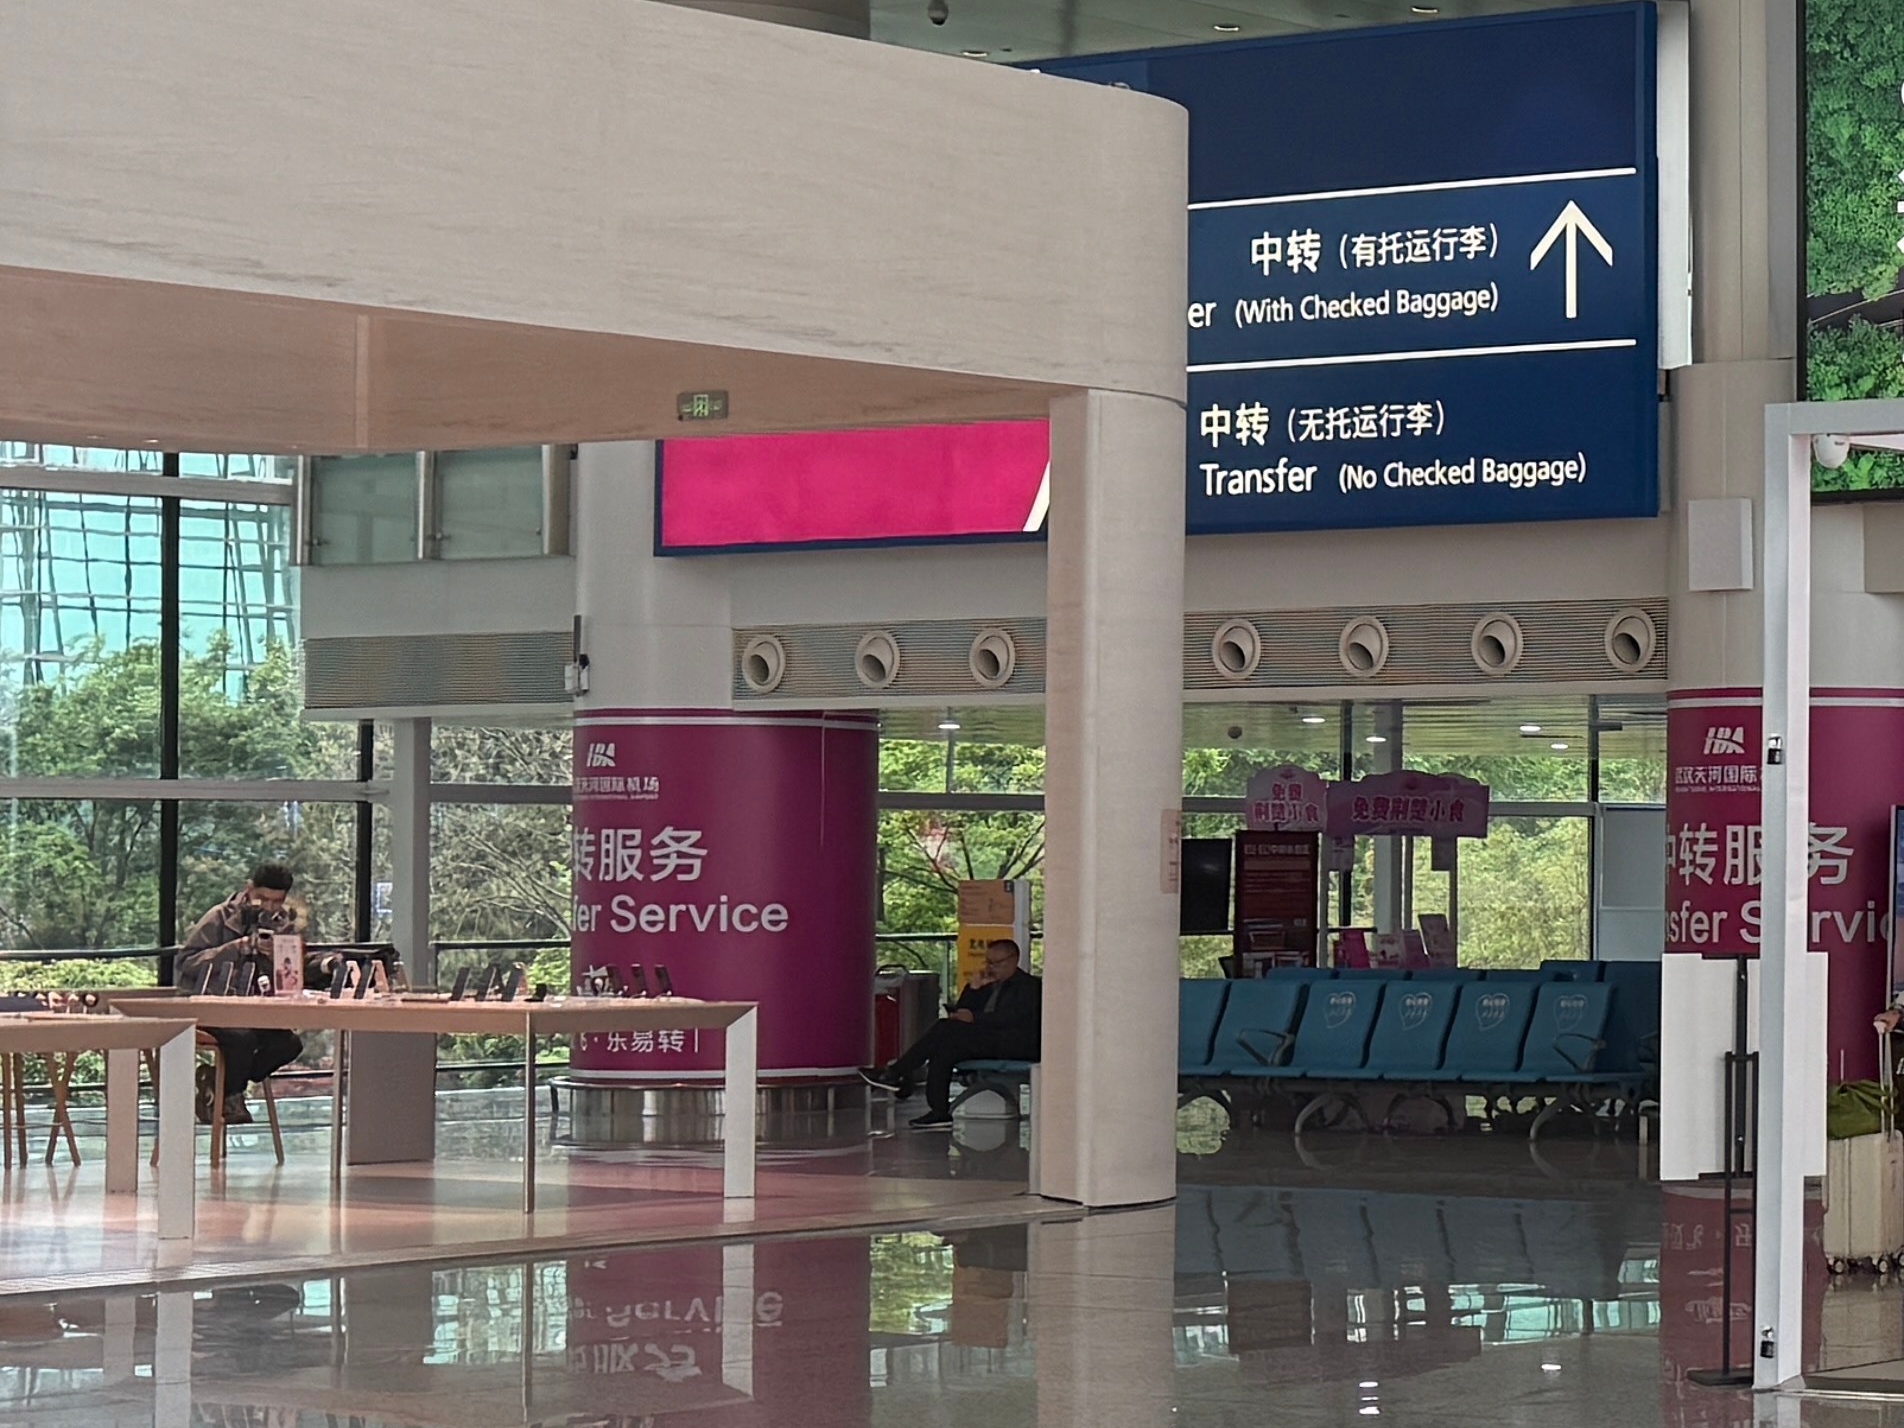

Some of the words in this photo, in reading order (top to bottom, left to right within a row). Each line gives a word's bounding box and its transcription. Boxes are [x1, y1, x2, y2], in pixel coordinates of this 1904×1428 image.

[1250, 228, 1321, 275] 中转
[1234, 297, 1293, 328] (With
[1300, 288, 1389, 321] Checked
[1396, 281, 1499, 319] Baggage)
[1200, 401, 1270, 449] 中转
[1199, 456, 1318, 496] Transfer
[1338, 462, 1378, 494] (No
[1383, 456, 1475, 490] Checked
[1481, 452, 1587, 489] Baggage)
[609, 894, 789, 933] Service
